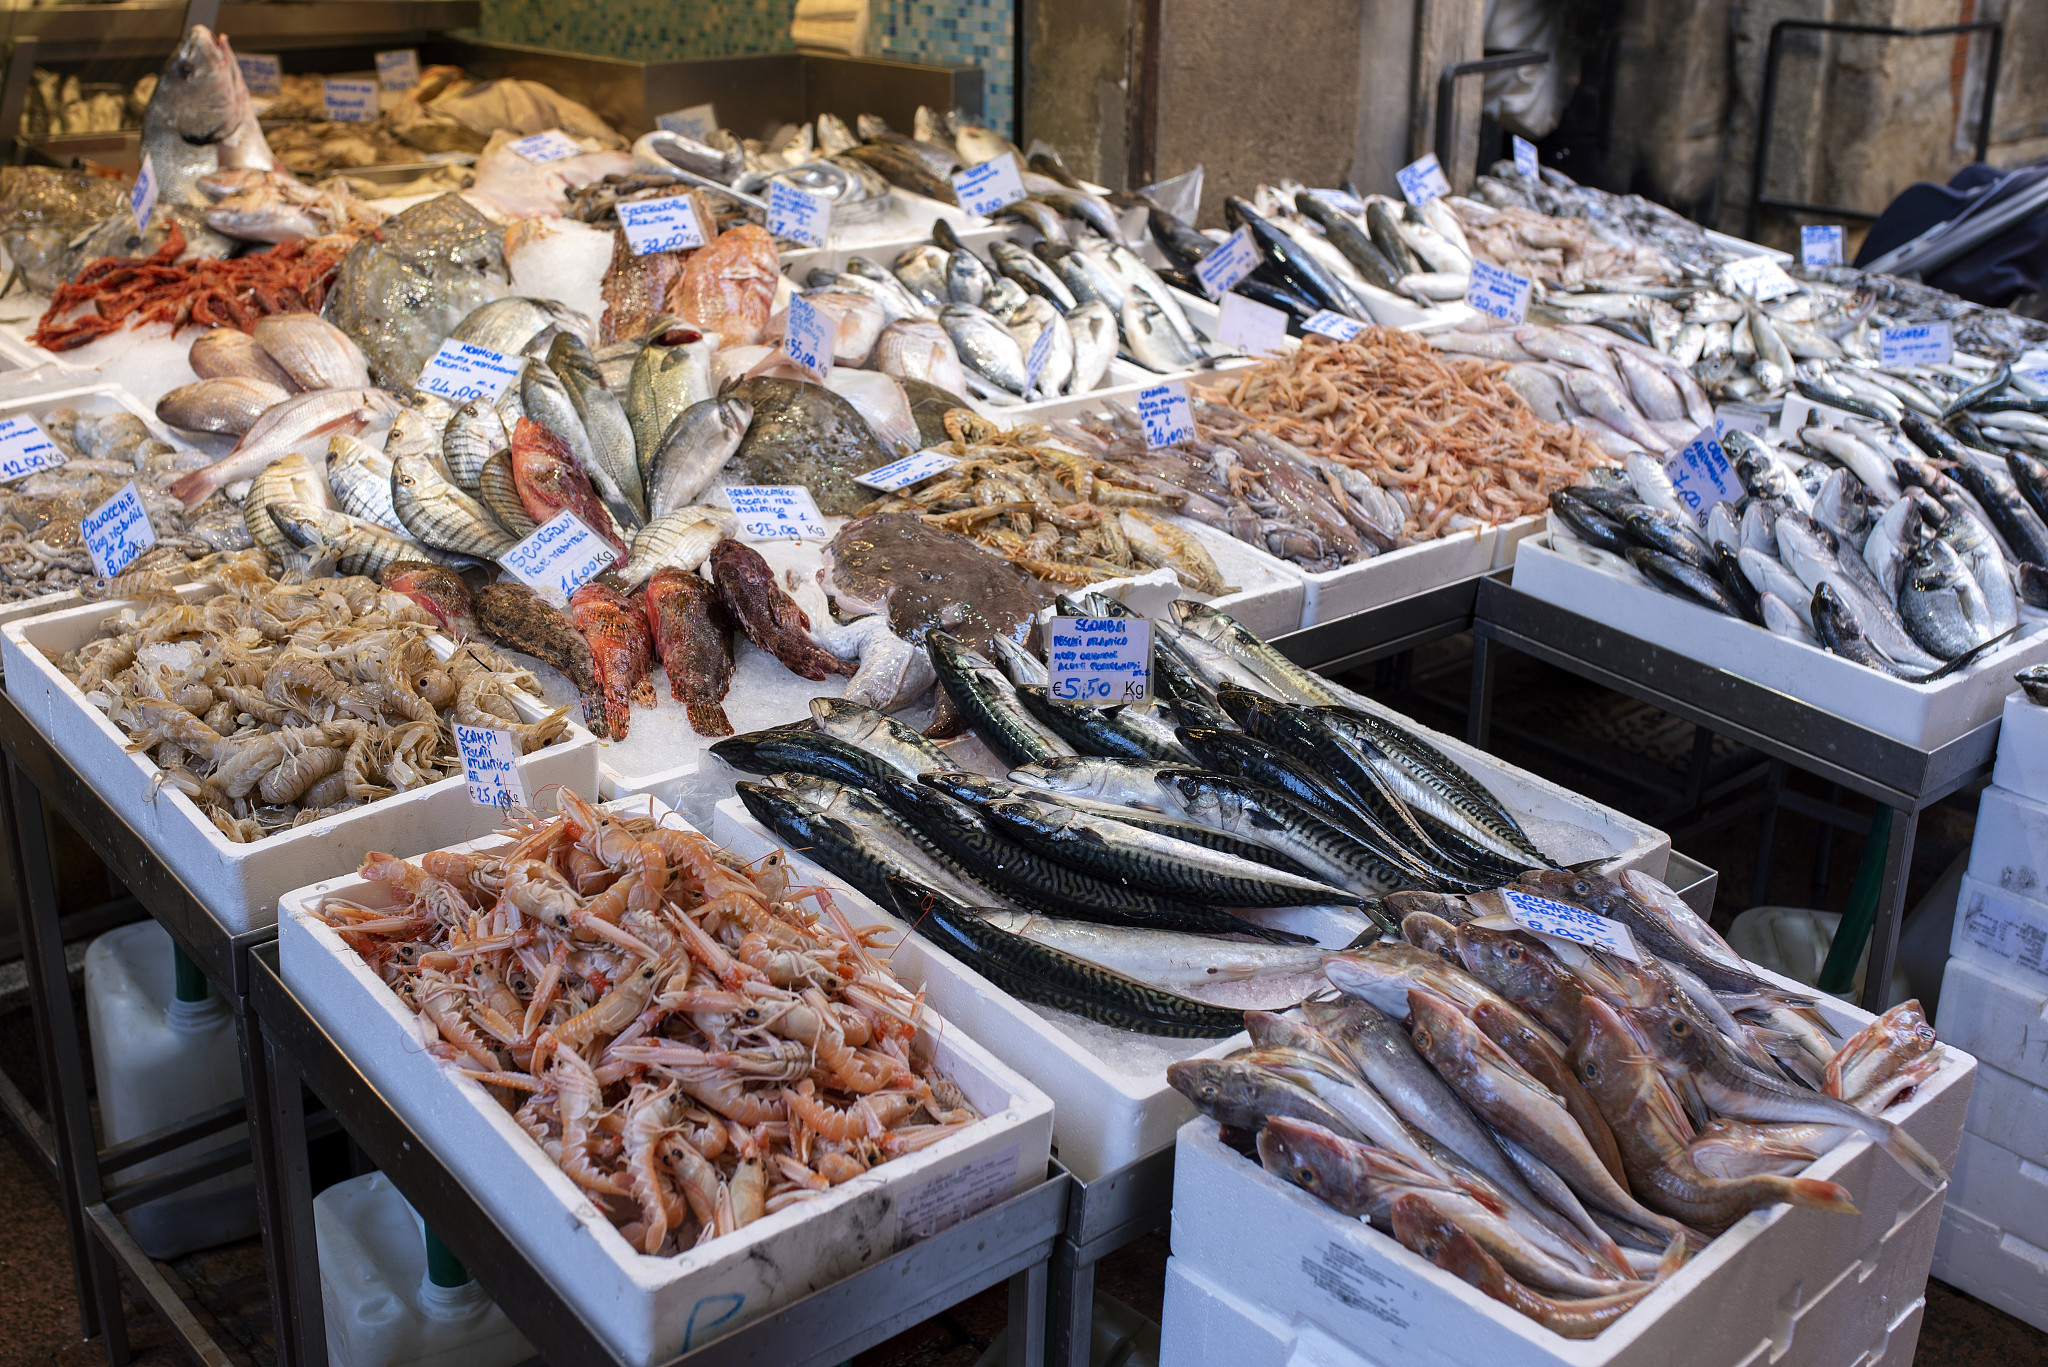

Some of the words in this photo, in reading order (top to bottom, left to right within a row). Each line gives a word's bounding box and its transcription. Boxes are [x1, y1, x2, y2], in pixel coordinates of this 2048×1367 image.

[806, 524, 826, 537] Kg
[593, 550, 615, 566] Kg
[1125, 681, 1144, 700] Kg
